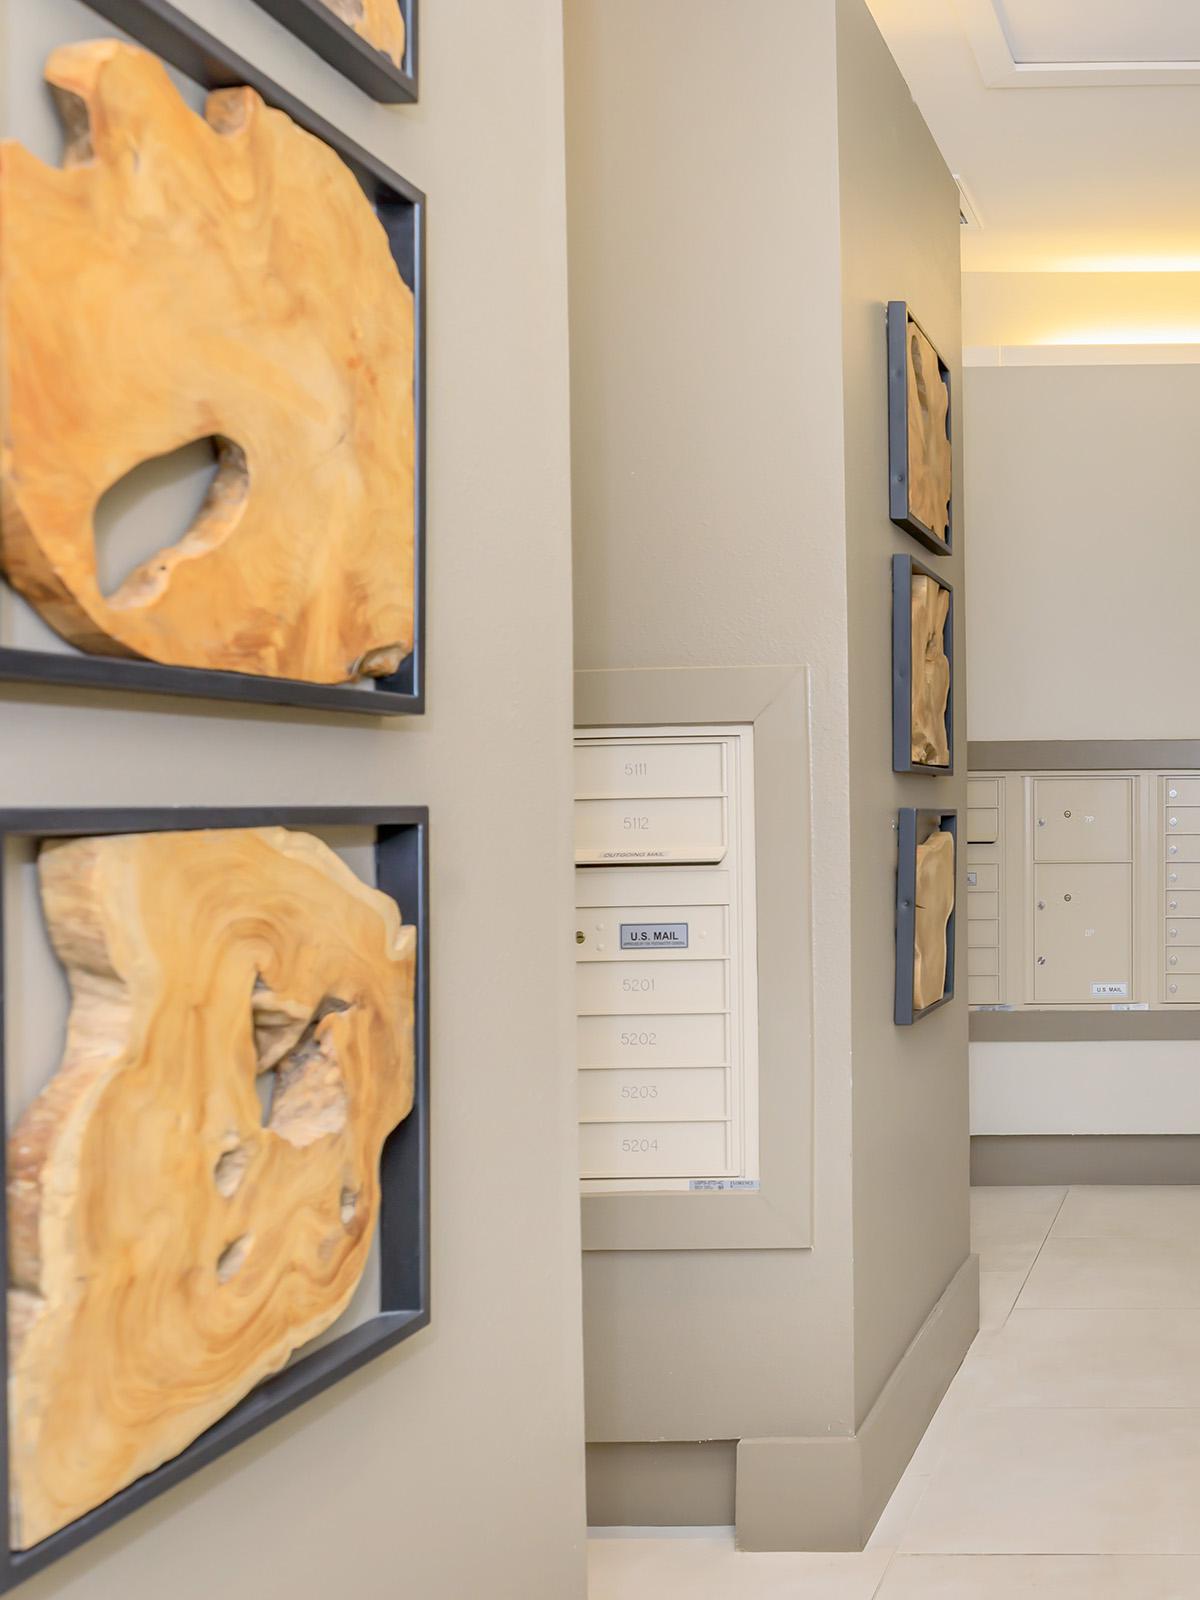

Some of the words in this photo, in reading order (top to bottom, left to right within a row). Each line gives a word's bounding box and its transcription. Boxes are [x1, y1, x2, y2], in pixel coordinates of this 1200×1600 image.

[624, 762, 648, 777] 5111
[623, 816, 649, 831] 5112
[630, 931, 651, 942] U.S.
[653, 931, 679, 941] MAIL
[621, 978, 656, 993] 5201
[620, 1032, 657, 1047] 5202
[620, 1085, 659, 1100] 5203
[621, 1138, 659, 1154] 5204
